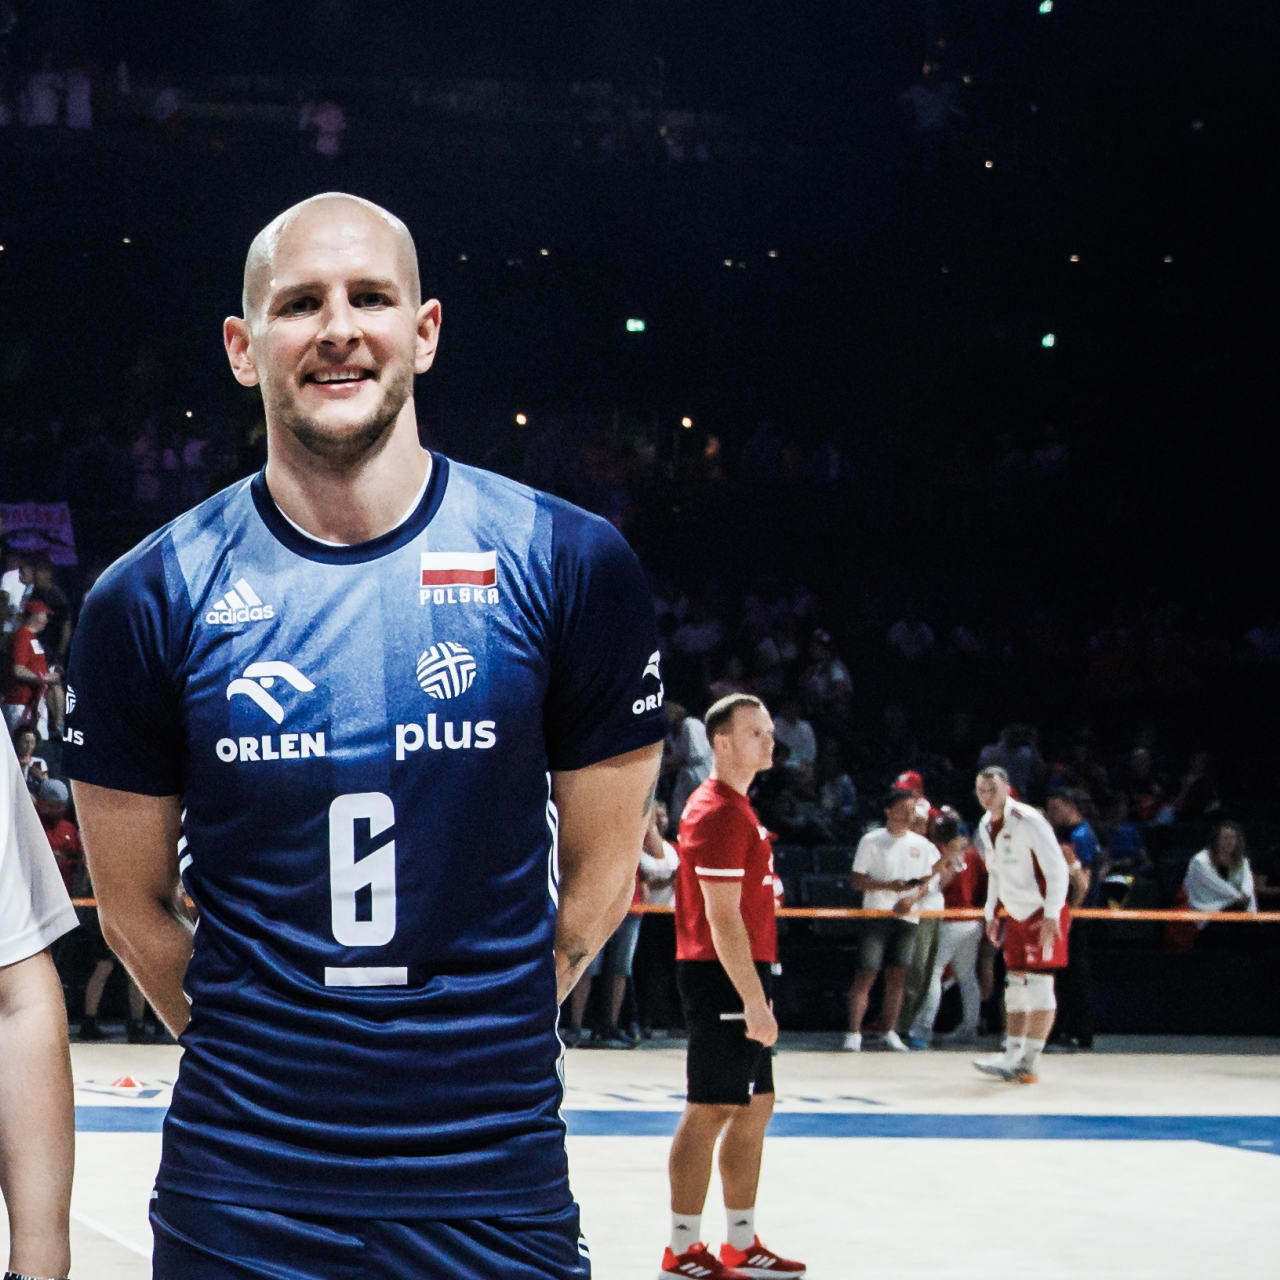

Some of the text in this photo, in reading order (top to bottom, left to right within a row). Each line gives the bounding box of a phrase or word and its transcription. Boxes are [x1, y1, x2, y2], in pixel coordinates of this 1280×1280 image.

[420, 587, 500, 605] POLSKA
[206, 603, 275, 625] adidas
[215, 732, 326, 763] ORLEN
[395, 713, 498, 761] plus
[328, 791, 397, 947] 6
